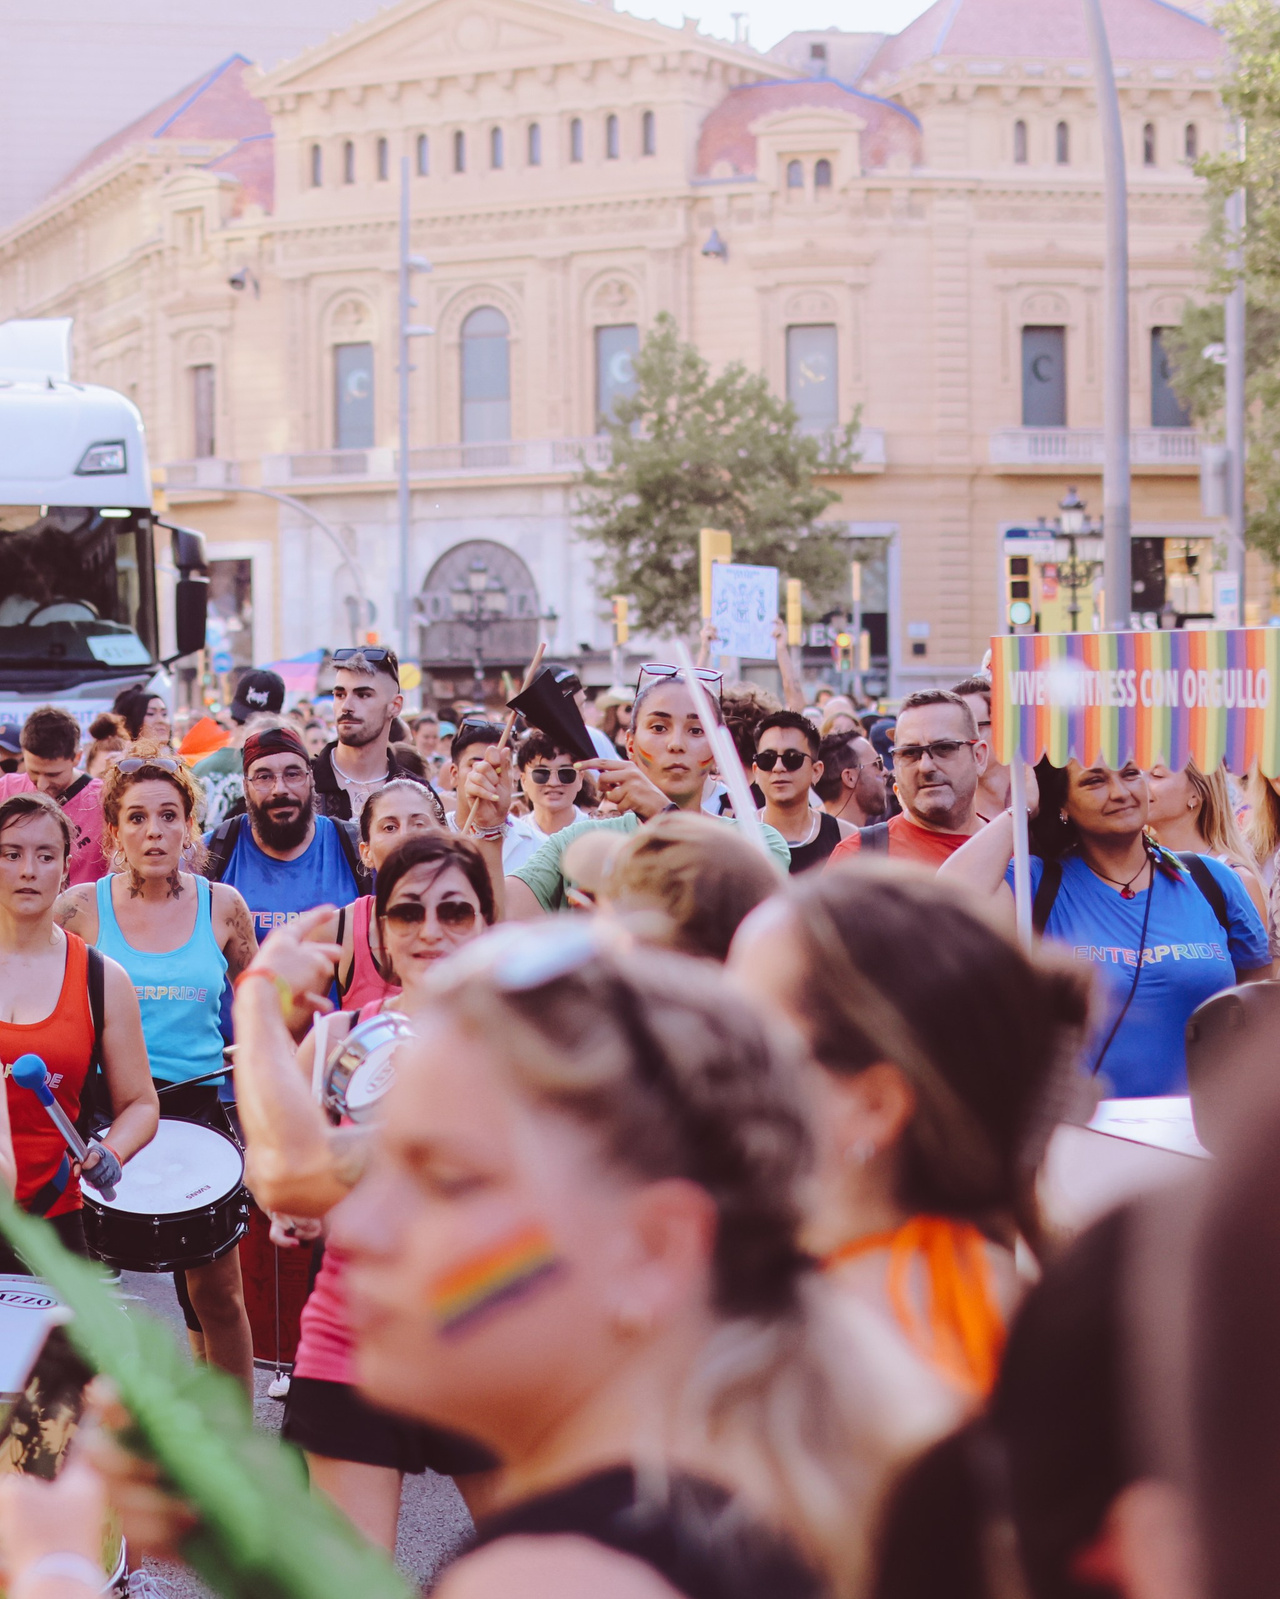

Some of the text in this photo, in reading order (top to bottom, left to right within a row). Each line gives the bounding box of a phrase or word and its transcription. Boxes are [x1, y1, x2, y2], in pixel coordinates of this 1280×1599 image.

[1140, 668, 1179, 708] CON
[1182, 668, 1271, 709] ORGULLO
[1073, 942, 1227, 968] ENTERPRIDE
